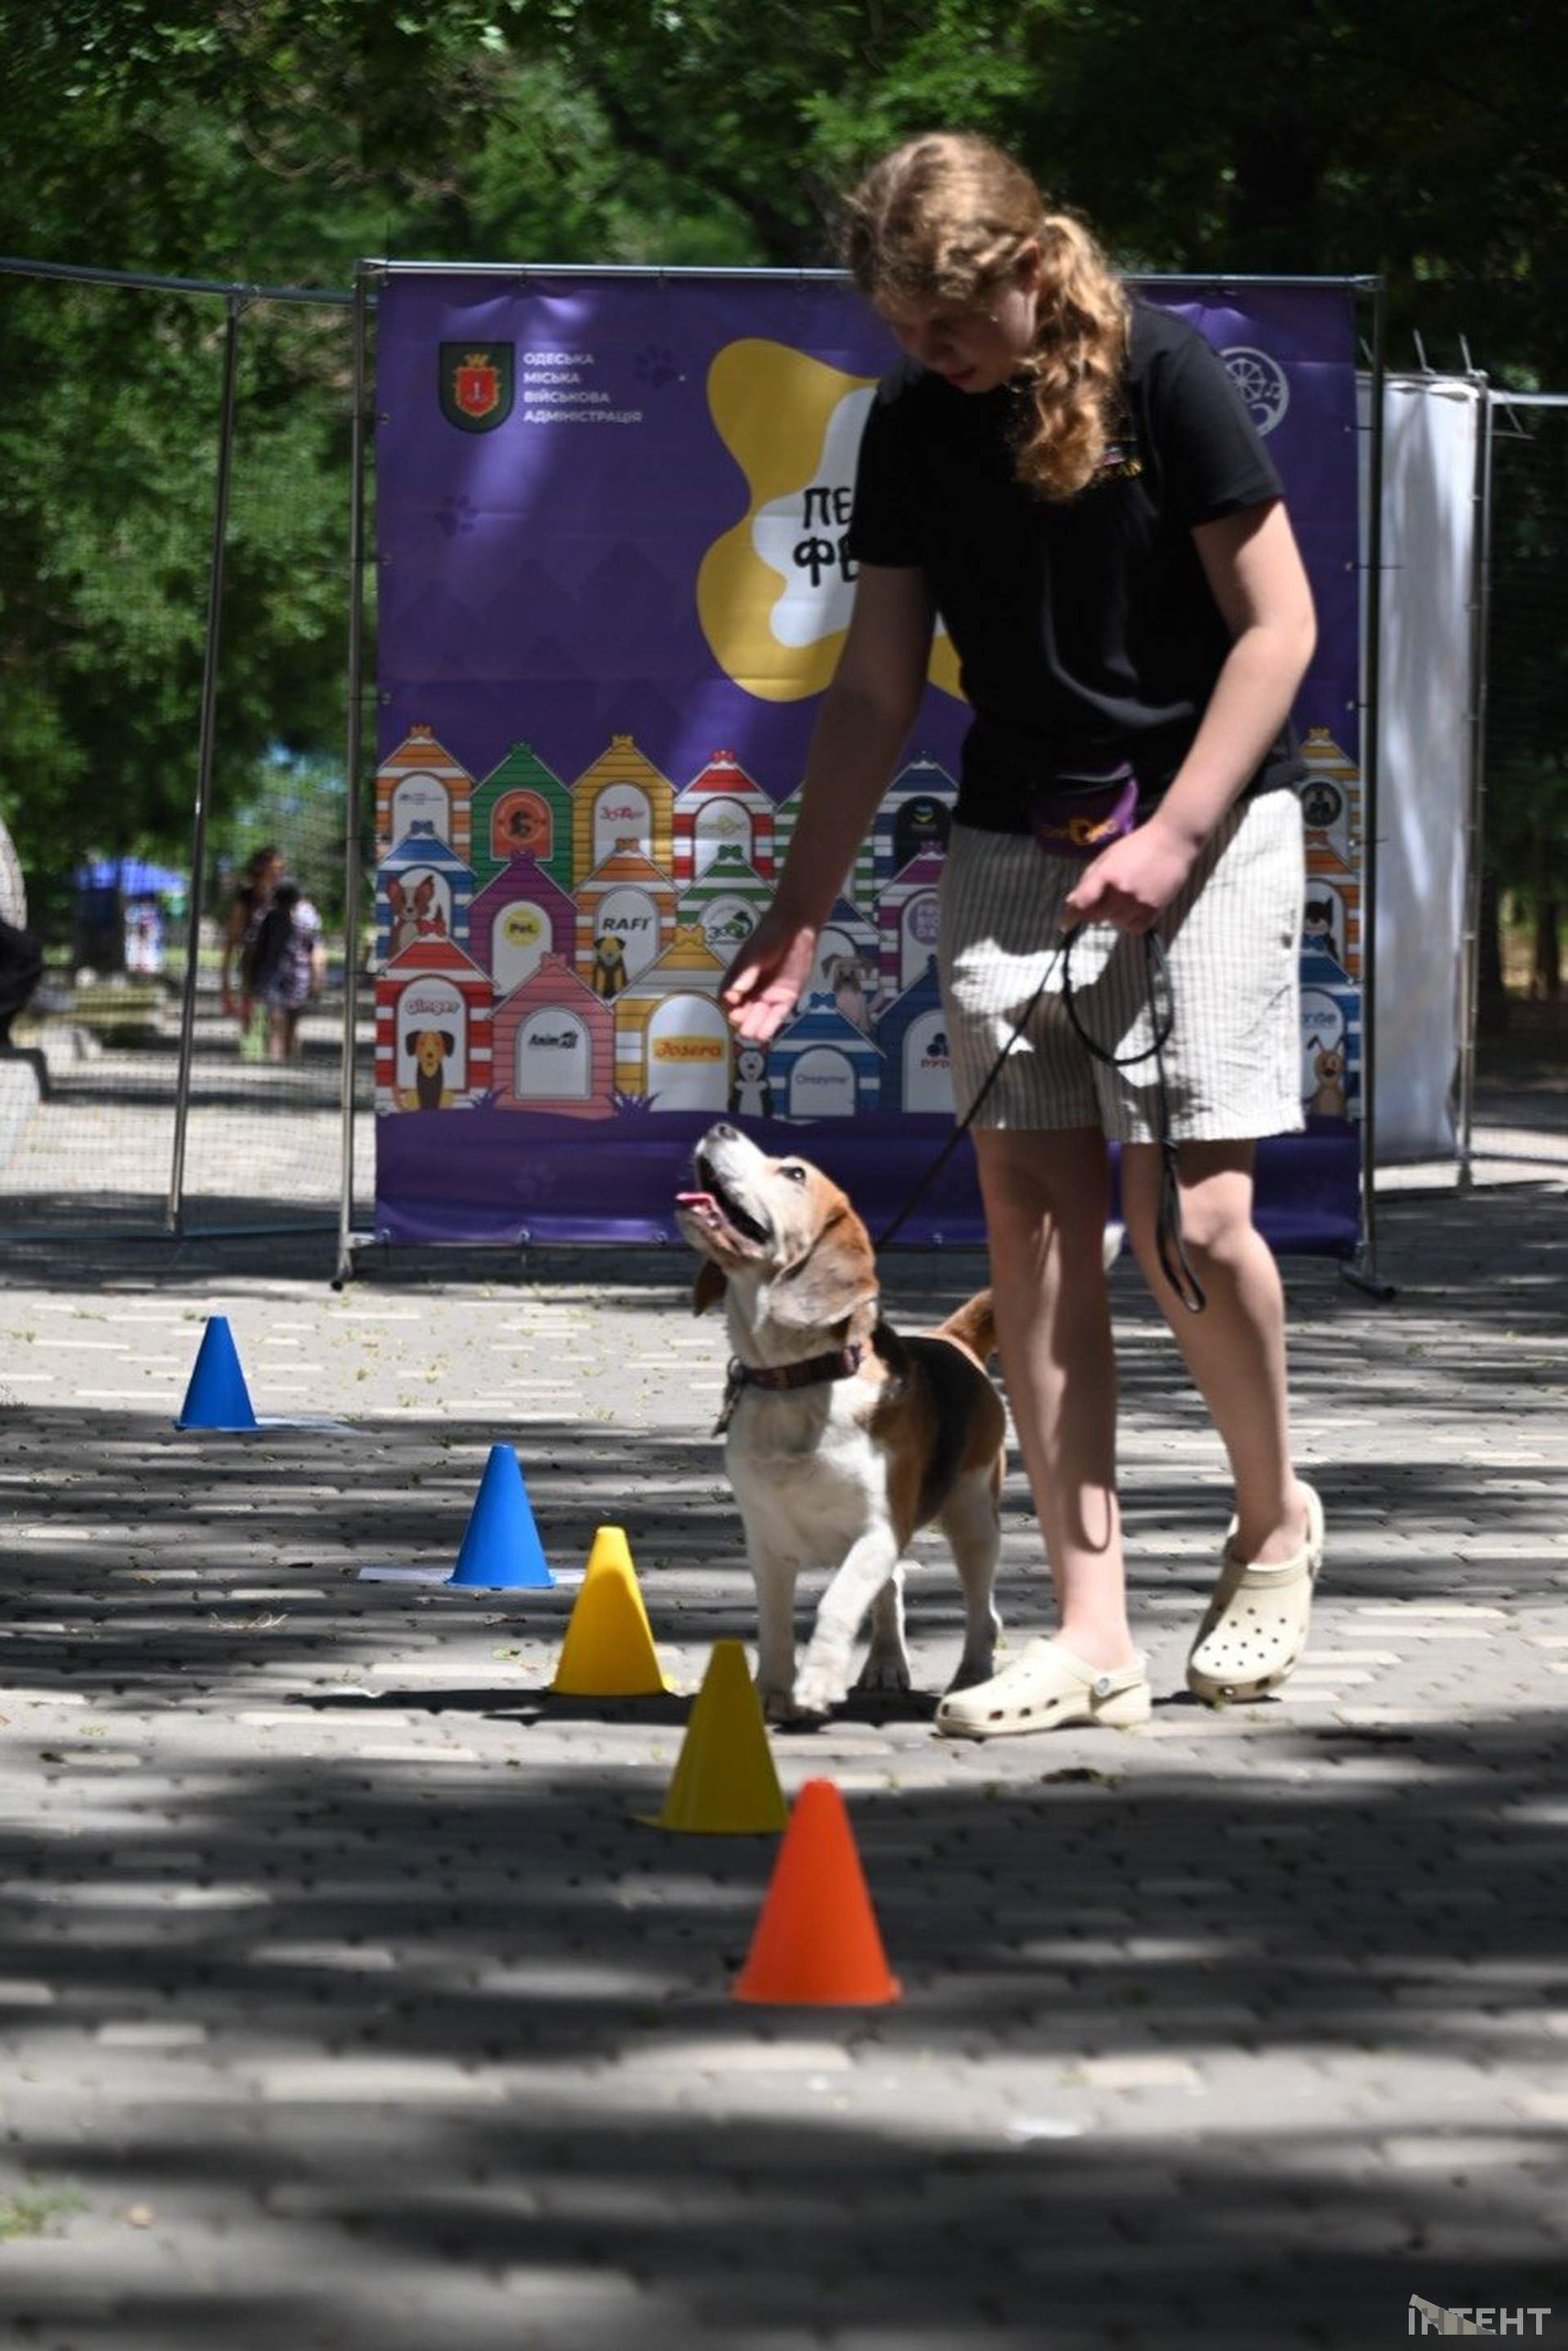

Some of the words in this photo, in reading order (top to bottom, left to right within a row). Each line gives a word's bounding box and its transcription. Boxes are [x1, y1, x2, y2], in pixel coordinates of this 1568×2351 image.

[523, 353, 595, 366] ОДЕСЬКА
[523, 373, 580, 384] МІСЬКА
[523, 389, 610, 403] ВІЙСЬКОВА
[523, 410, 643, 424] АДМІНІСТРАЦІЯ
[602, 917, 652, 930] RAFI
